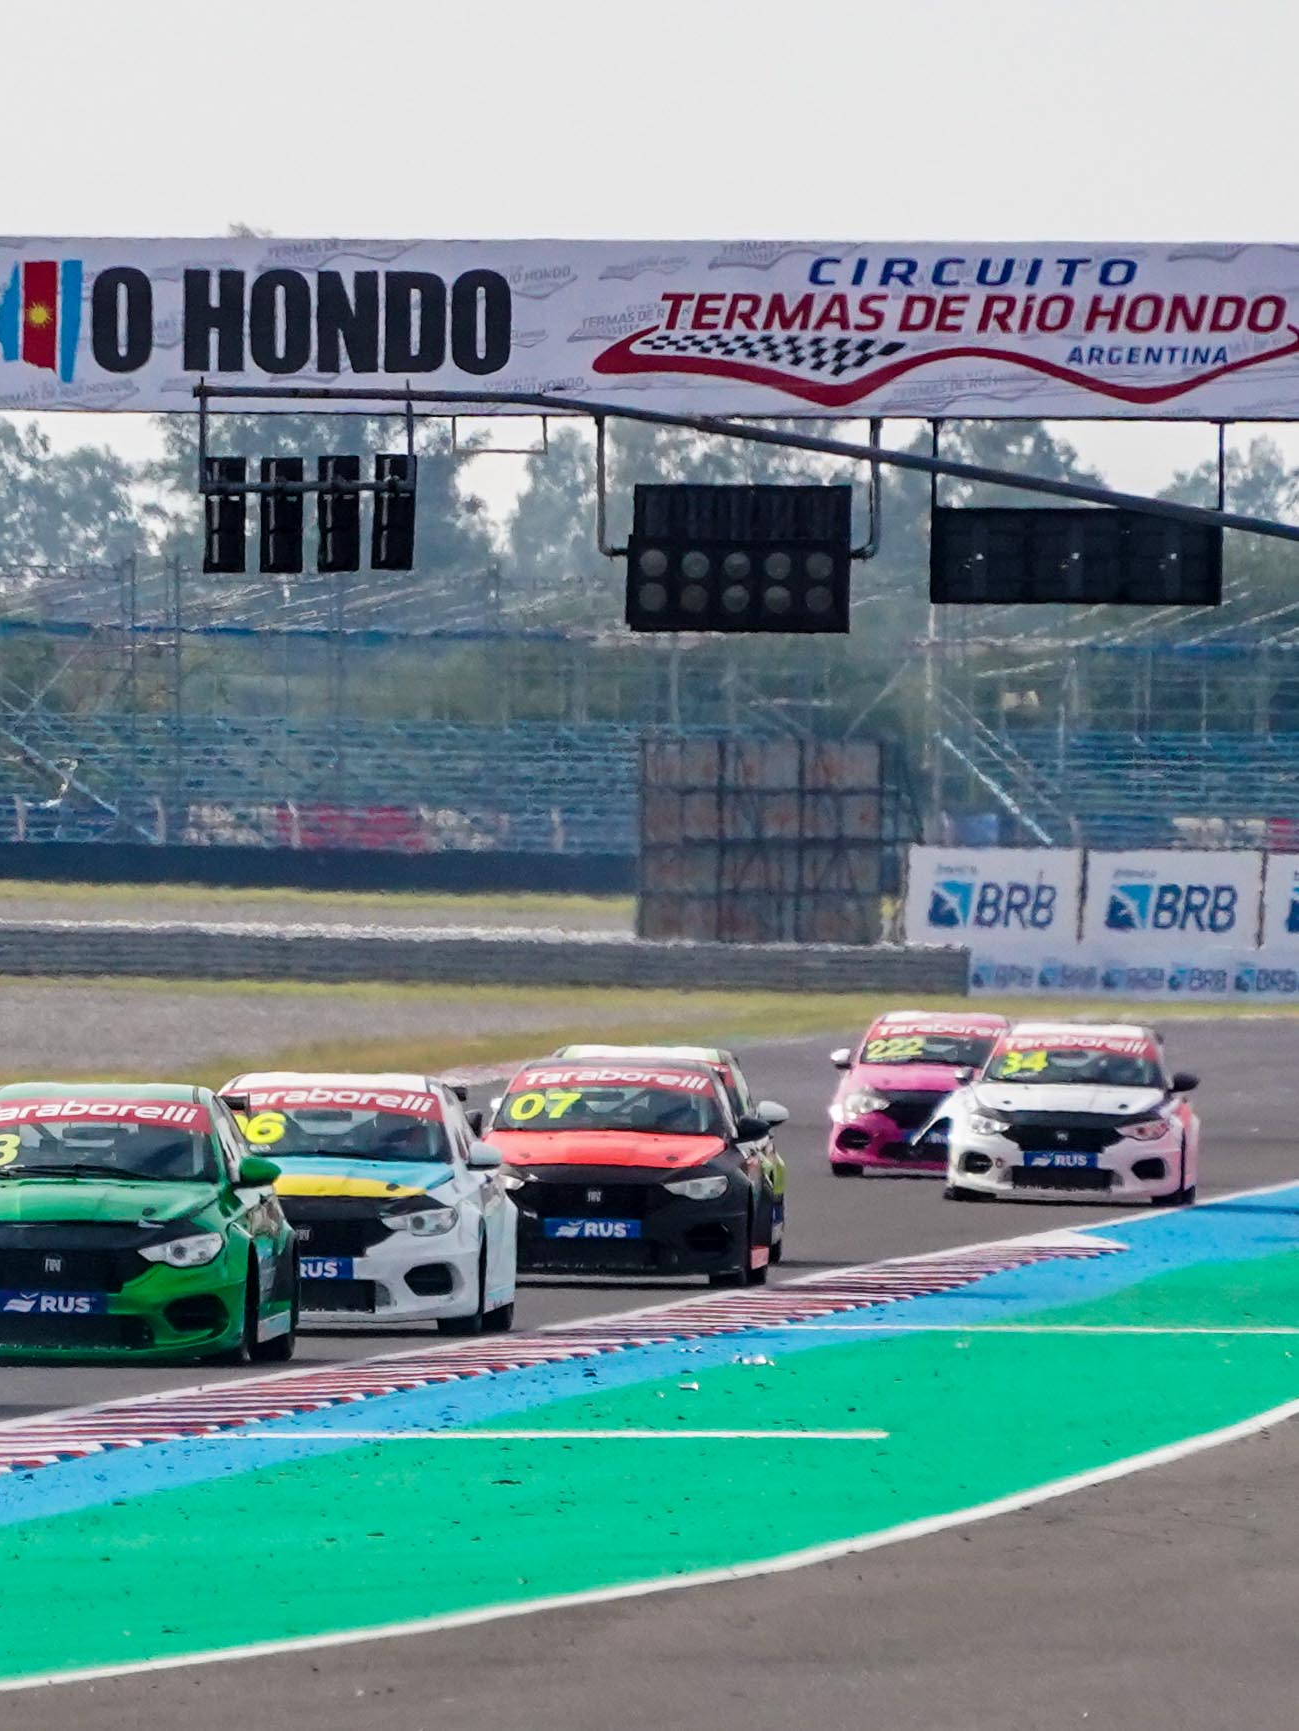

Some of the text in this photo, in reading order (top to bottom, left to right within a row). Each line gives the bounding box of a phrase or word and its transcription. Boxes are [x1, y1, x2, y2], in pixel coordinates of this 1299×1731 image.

[809, 256, 1138, 287] CIRCUITO
[182, 269, 510, 375] HONDO
[662, 292, 887, 331] TERMAS
[898, 295, 964, 332] DE
[1084, 295, 1285, 334] HONDO
[1065, 345, 1229, 367] ARGENTINA
[974, 880, 1057, 929] BRB
[1152, 883, 1239, 934] BRB
[866, 1037, 925, 1060] 222
[1005, 1036, 1149, 1055] Taraborelli
[1001, 1051, 1048, 1076] 34
[525, 1069, 710, 1091] Taraborelli
[509, 1092, 583, 1121] 07
[1054, 1155, 1088, 1167] RUS
[584, 1222, 627, 1238] RUS
[40, 1296, 91, 1313] RUS
